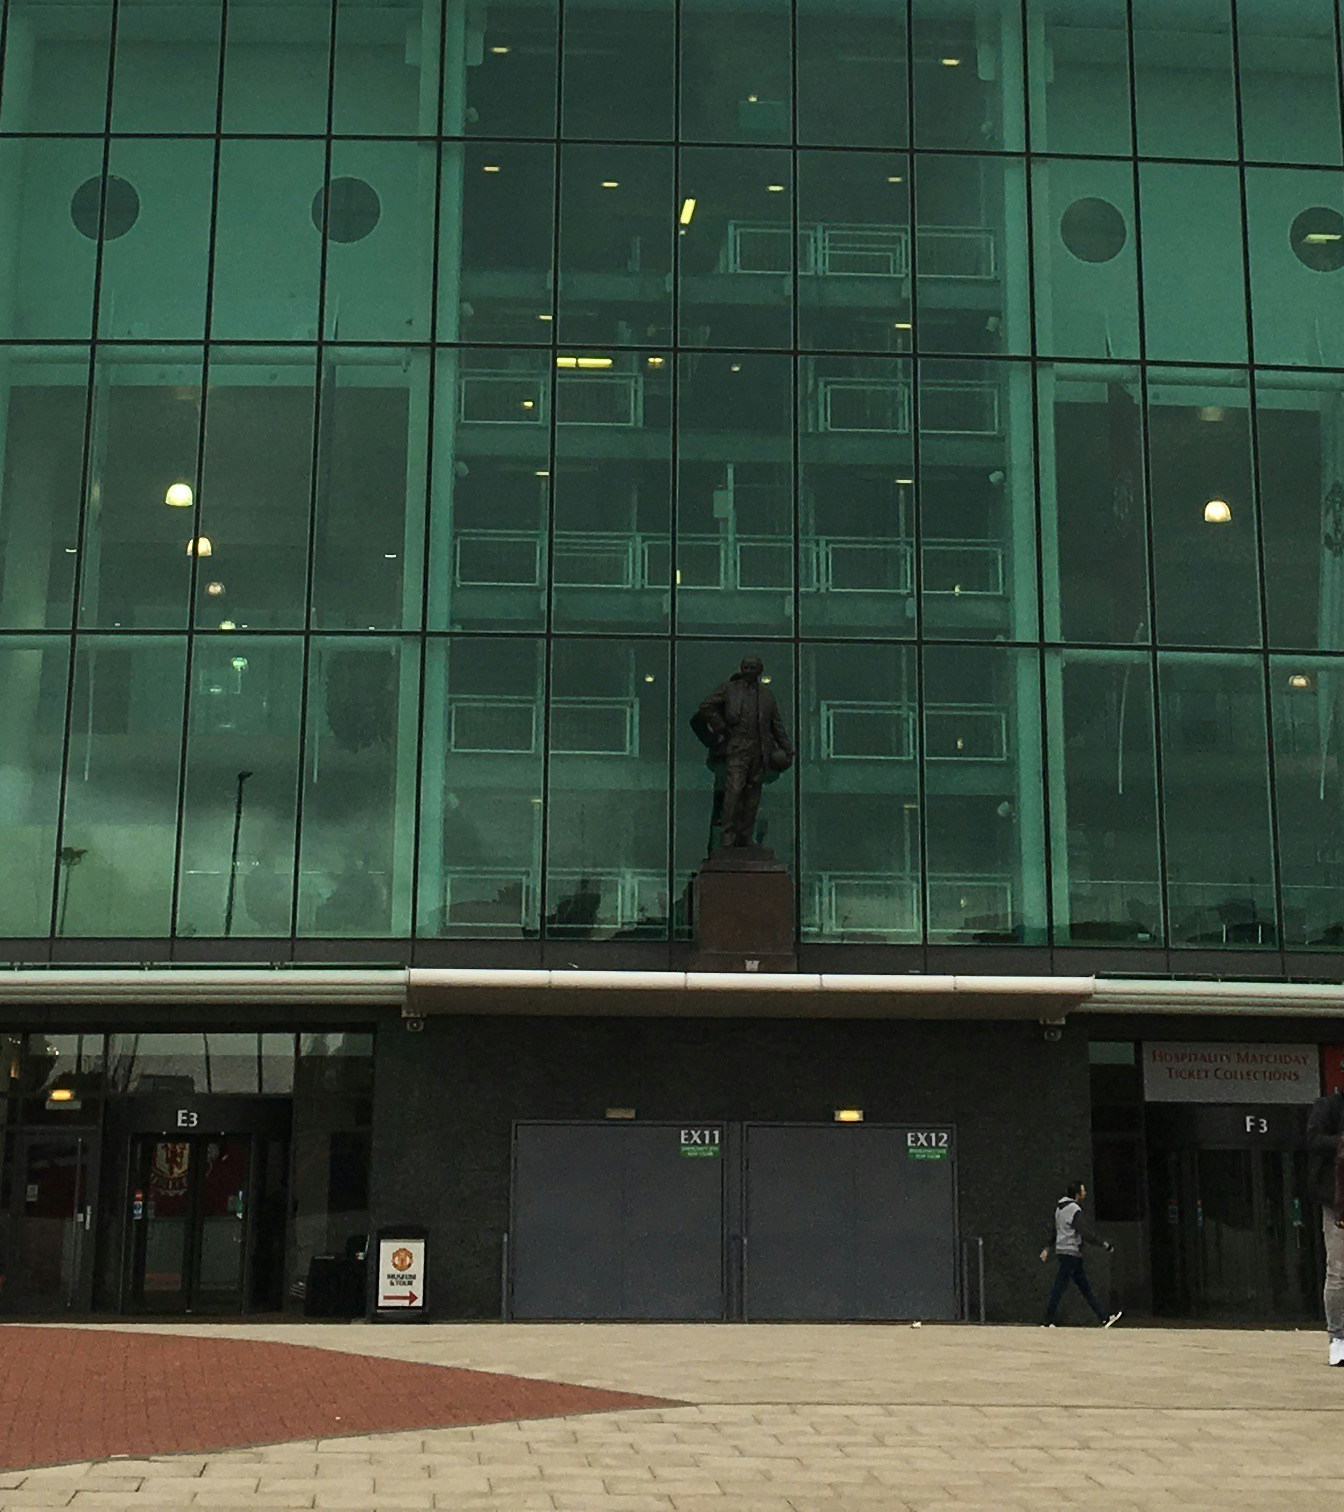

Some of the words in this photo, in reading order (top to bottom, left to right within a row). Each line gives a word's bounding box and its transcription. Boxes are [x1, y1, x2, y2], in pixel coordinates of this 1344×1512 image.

[1152, 1049, 1231, 1064] HOSPITALITY
[1236, 1050, 1309, 1065] MATCHDAY
[1167, 1067, 1209, 1081] TICKET
[1214, 1067, 1301, 1082] COLLECTIONS
[177, 1109, 199, 1128] E3
[679, 1129, 721, 1145] EX11
[906, 1131, 949, 1148] EX12
